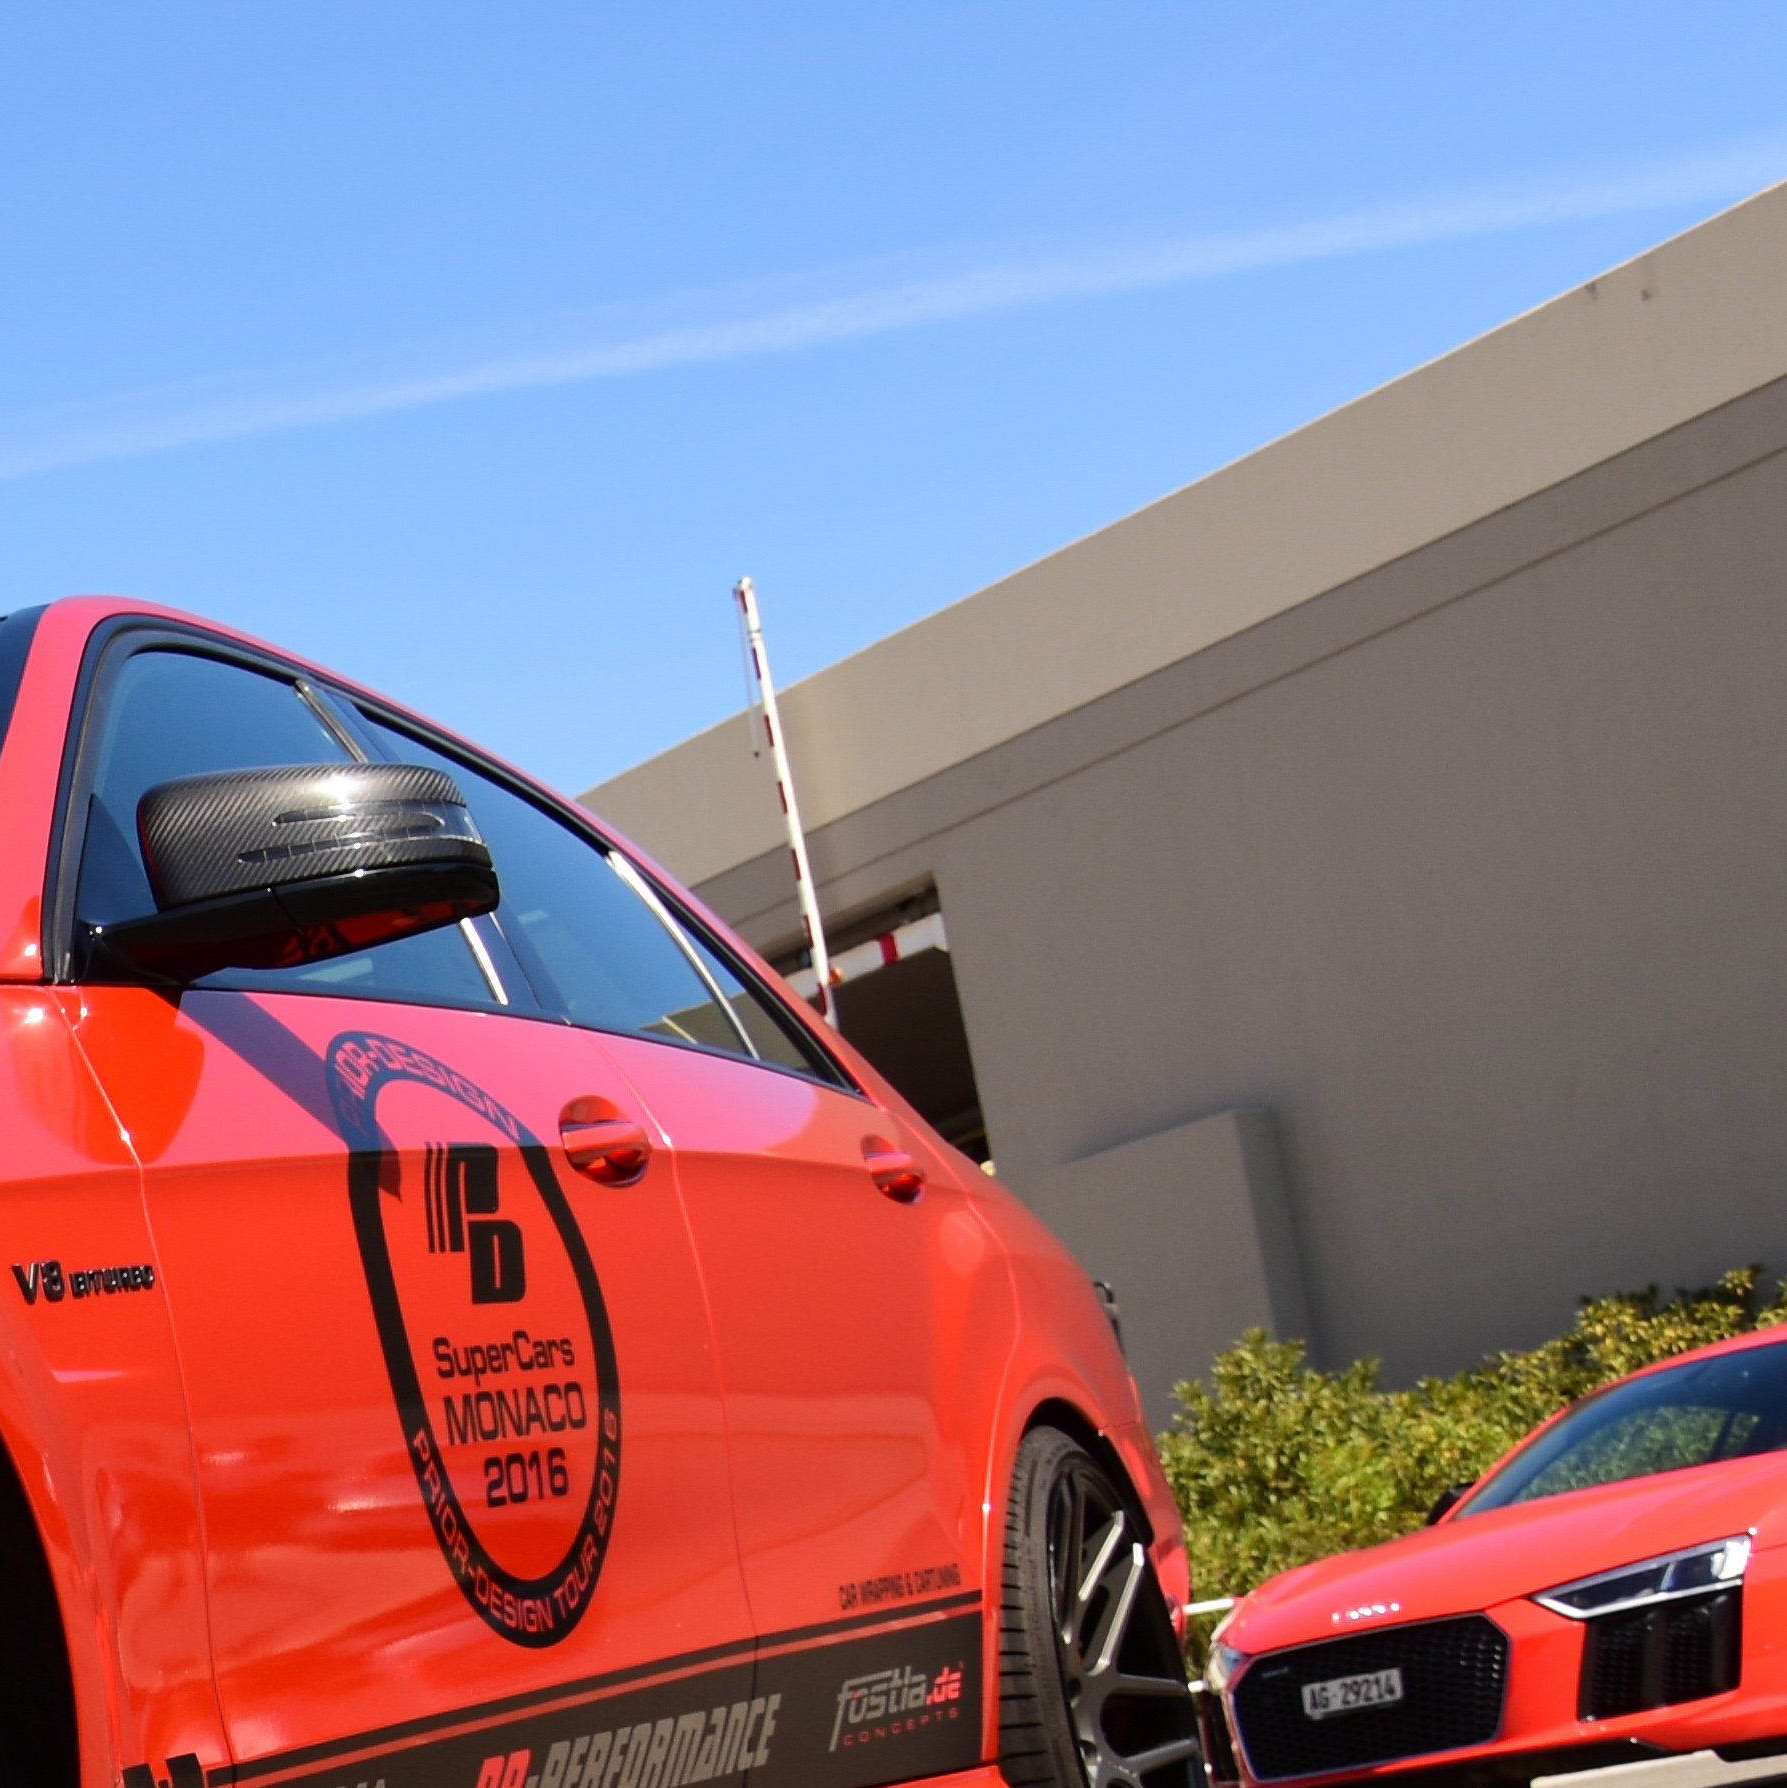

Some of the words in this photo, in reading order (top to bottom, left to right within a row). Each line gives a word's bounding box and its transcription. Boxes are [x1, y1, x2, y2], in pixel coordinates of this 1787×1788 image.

[12, 1260, 65, 1305] V8
[432, 1330, 575, 1386] SuperCars
[443, 1381, 588, 1446] MONACO
[483, 1447, 569, 1508] 2016
[413, 1428, 553, 1633] PRIOR-DESIGN
[552, 1533, 599, 1619] TOUR
[592, 1407, 619, 1534] 2016
[843, 1706, 959, 1747] CONCEPTS
